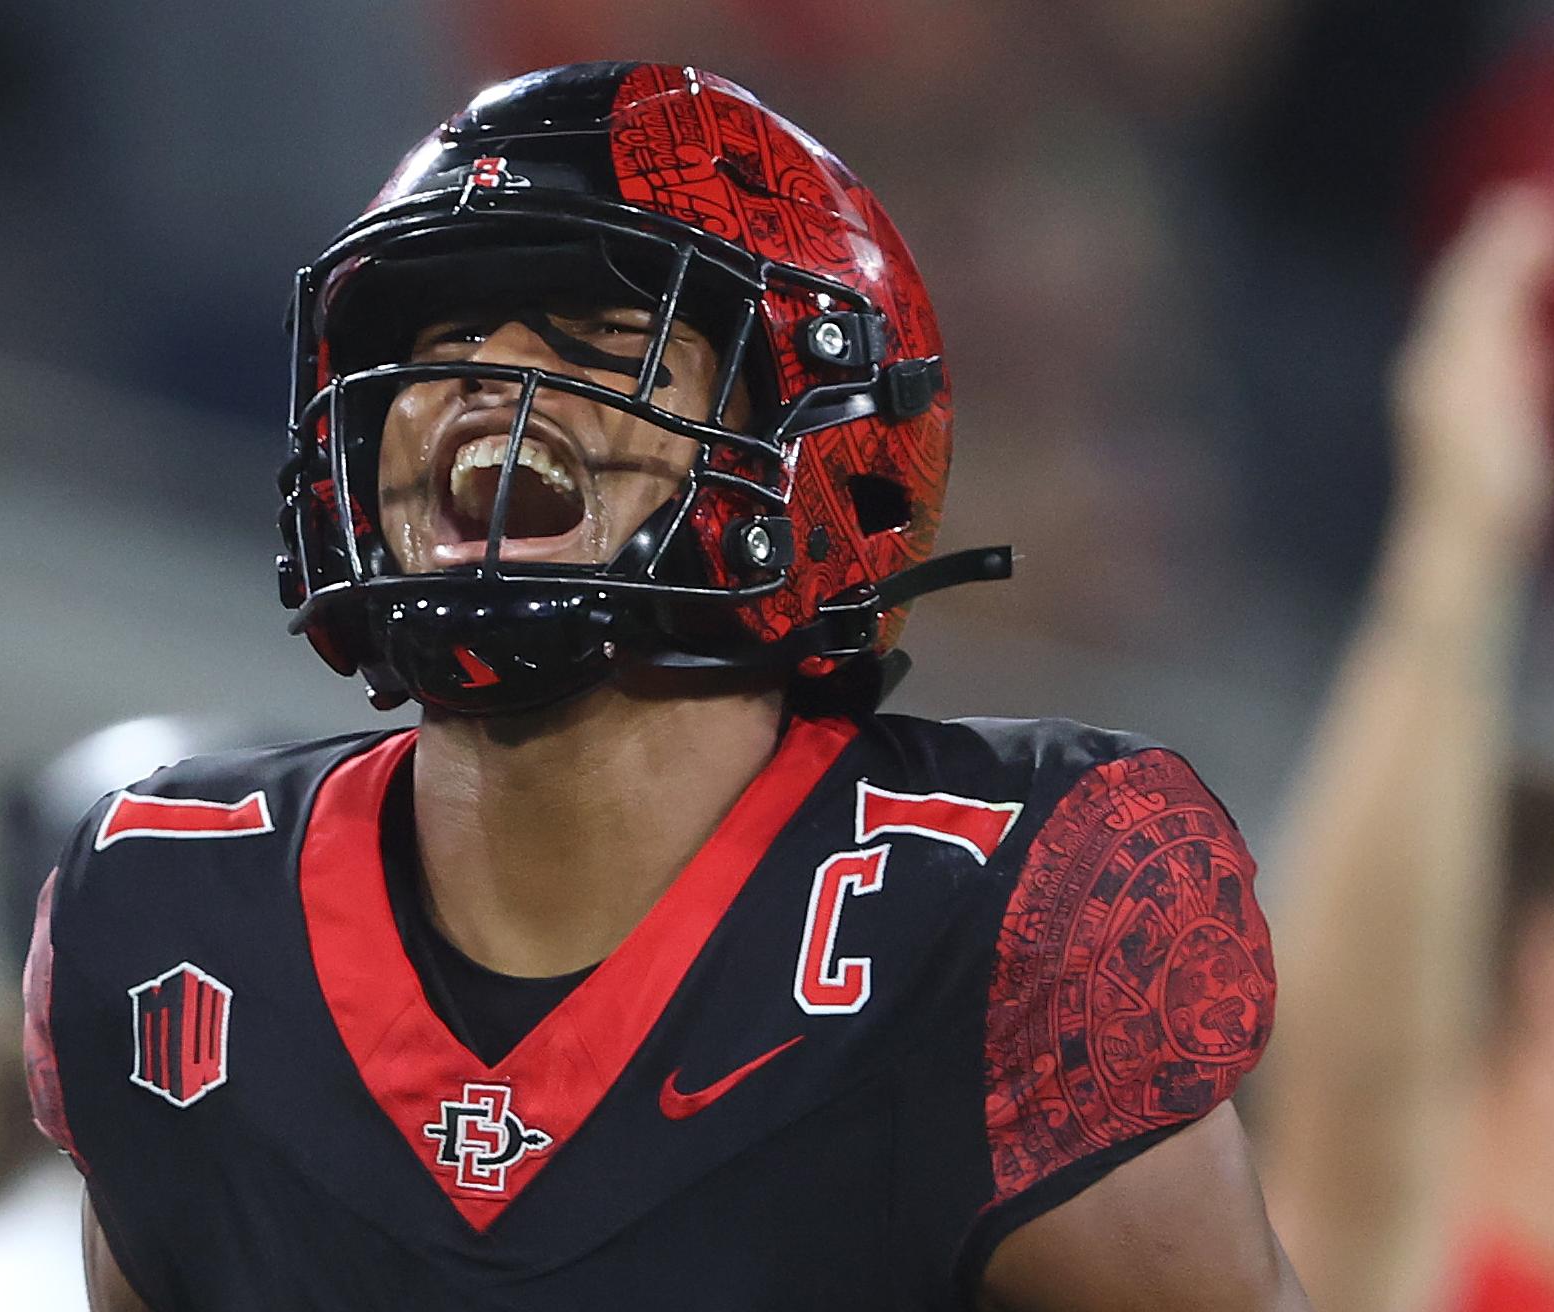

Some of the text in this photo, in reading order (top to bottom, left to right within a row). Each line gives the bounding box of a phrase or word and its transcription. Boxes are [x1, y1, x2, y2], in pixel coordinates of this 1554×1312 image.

[94, 790, 275, 852] 1
[855, 777, 1024, 866] 1
[793, 843, 892, 1015] C
